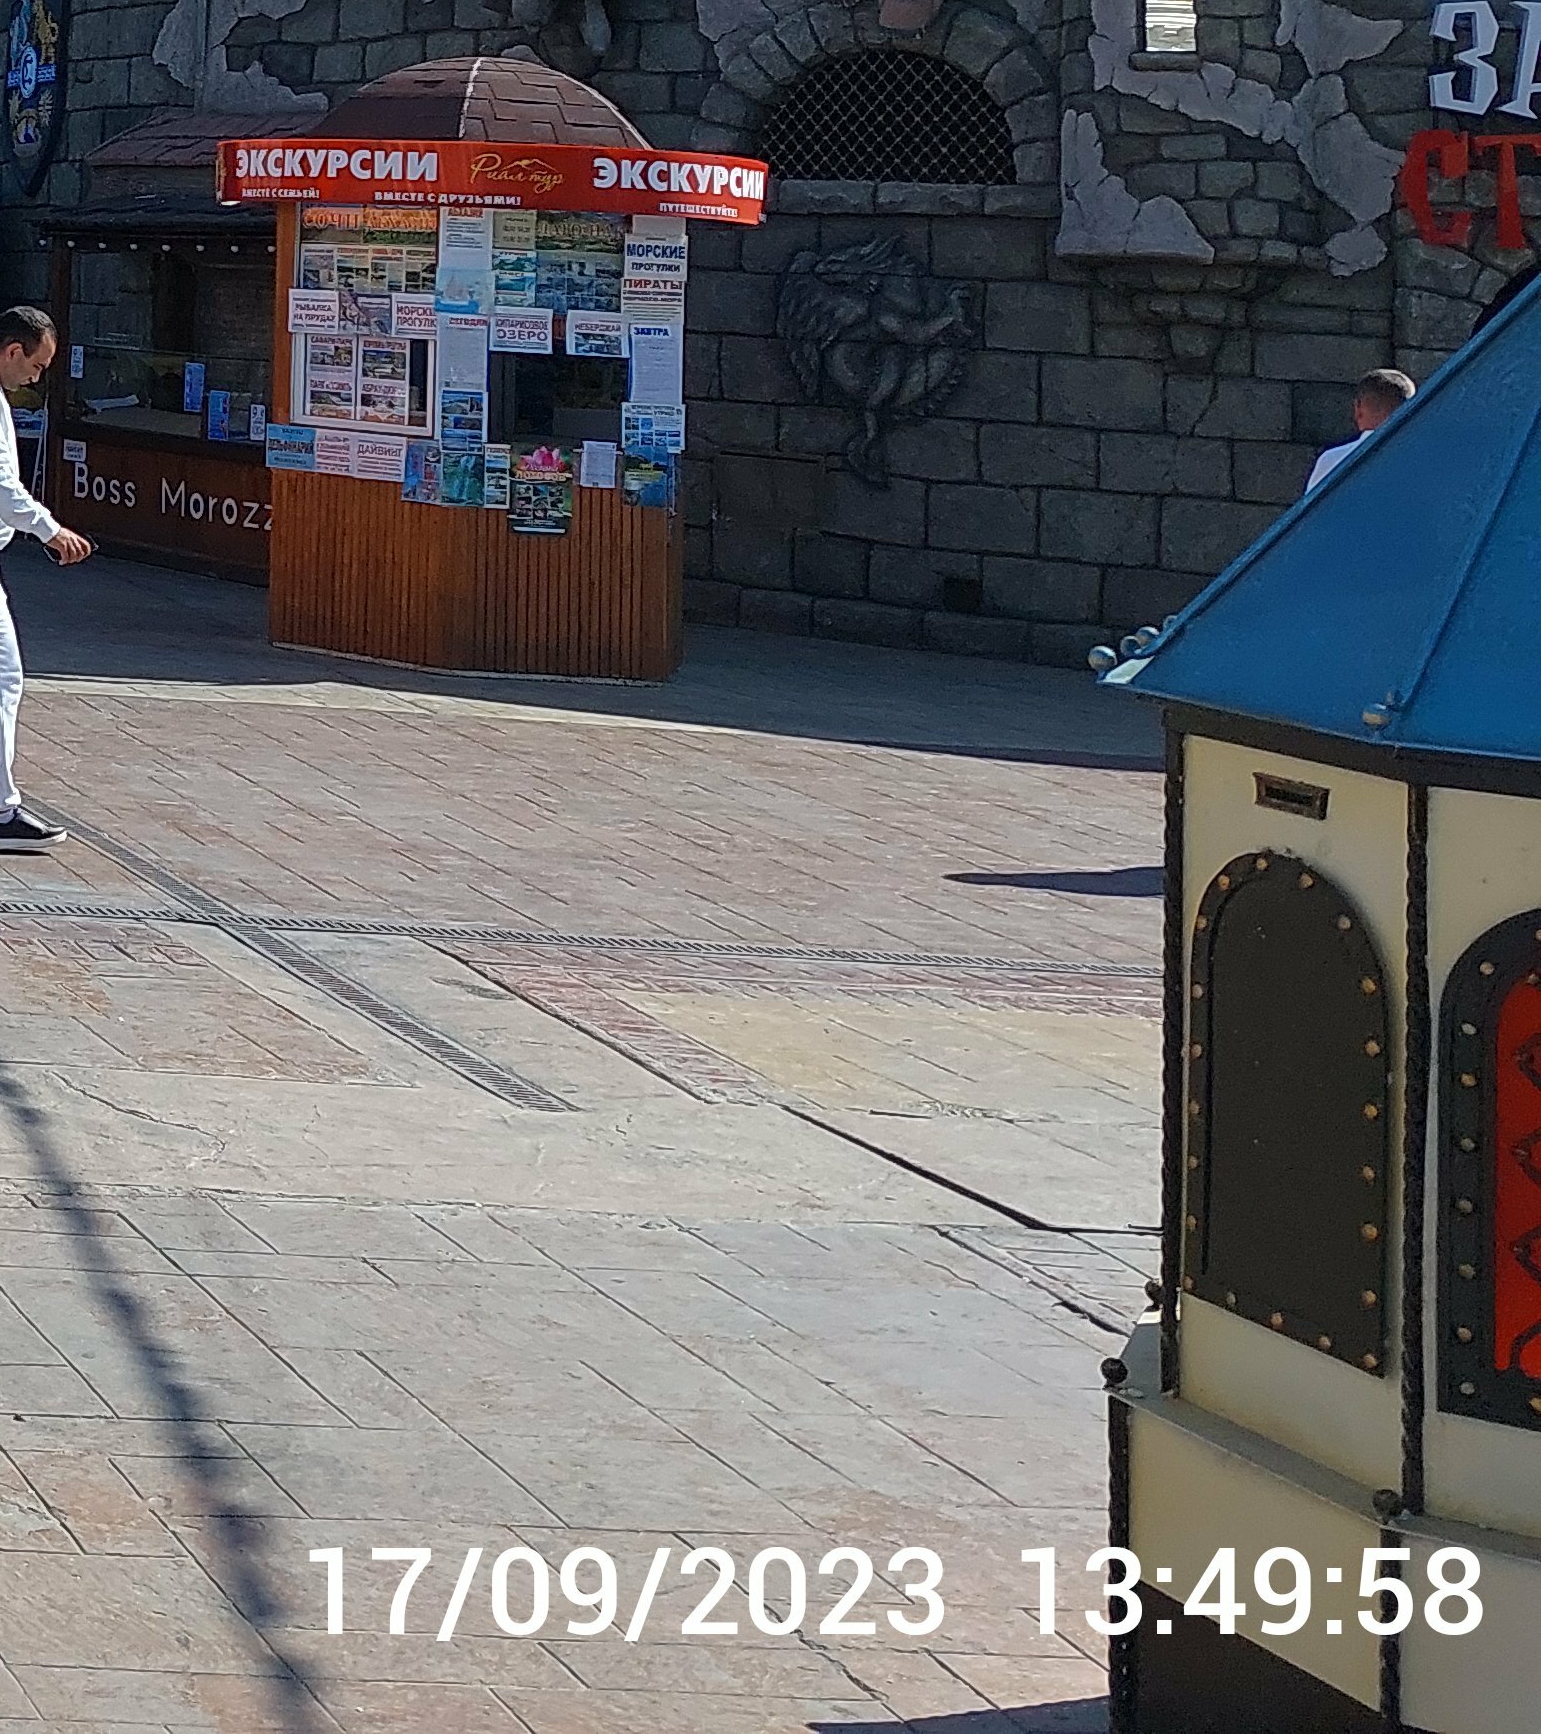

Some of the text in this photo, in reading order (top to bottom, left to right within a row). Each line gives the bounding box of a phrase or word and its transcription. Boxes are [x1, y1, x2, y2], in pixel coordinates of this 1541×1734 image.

[234, 148, 439, 183] ЭКСКУРСИИ
[592, 156, 767, 202] ЭКСКУРСИИ
[374, 191, 522, 206] ВМЕСТЕ С ДРУЗЬЯМИ!
[626, 243, 686, 260] МОРСКИЕ
[631, 261, 681, 273] ПРОГУЛКИ
[623, 278, 683, 290] ПИРАТЫ
[496, 328, 548, 342] ОЗЕРО
[633, 326, 669, 337] ЗАВТРА
[73, 461, 137, 509] Boss
